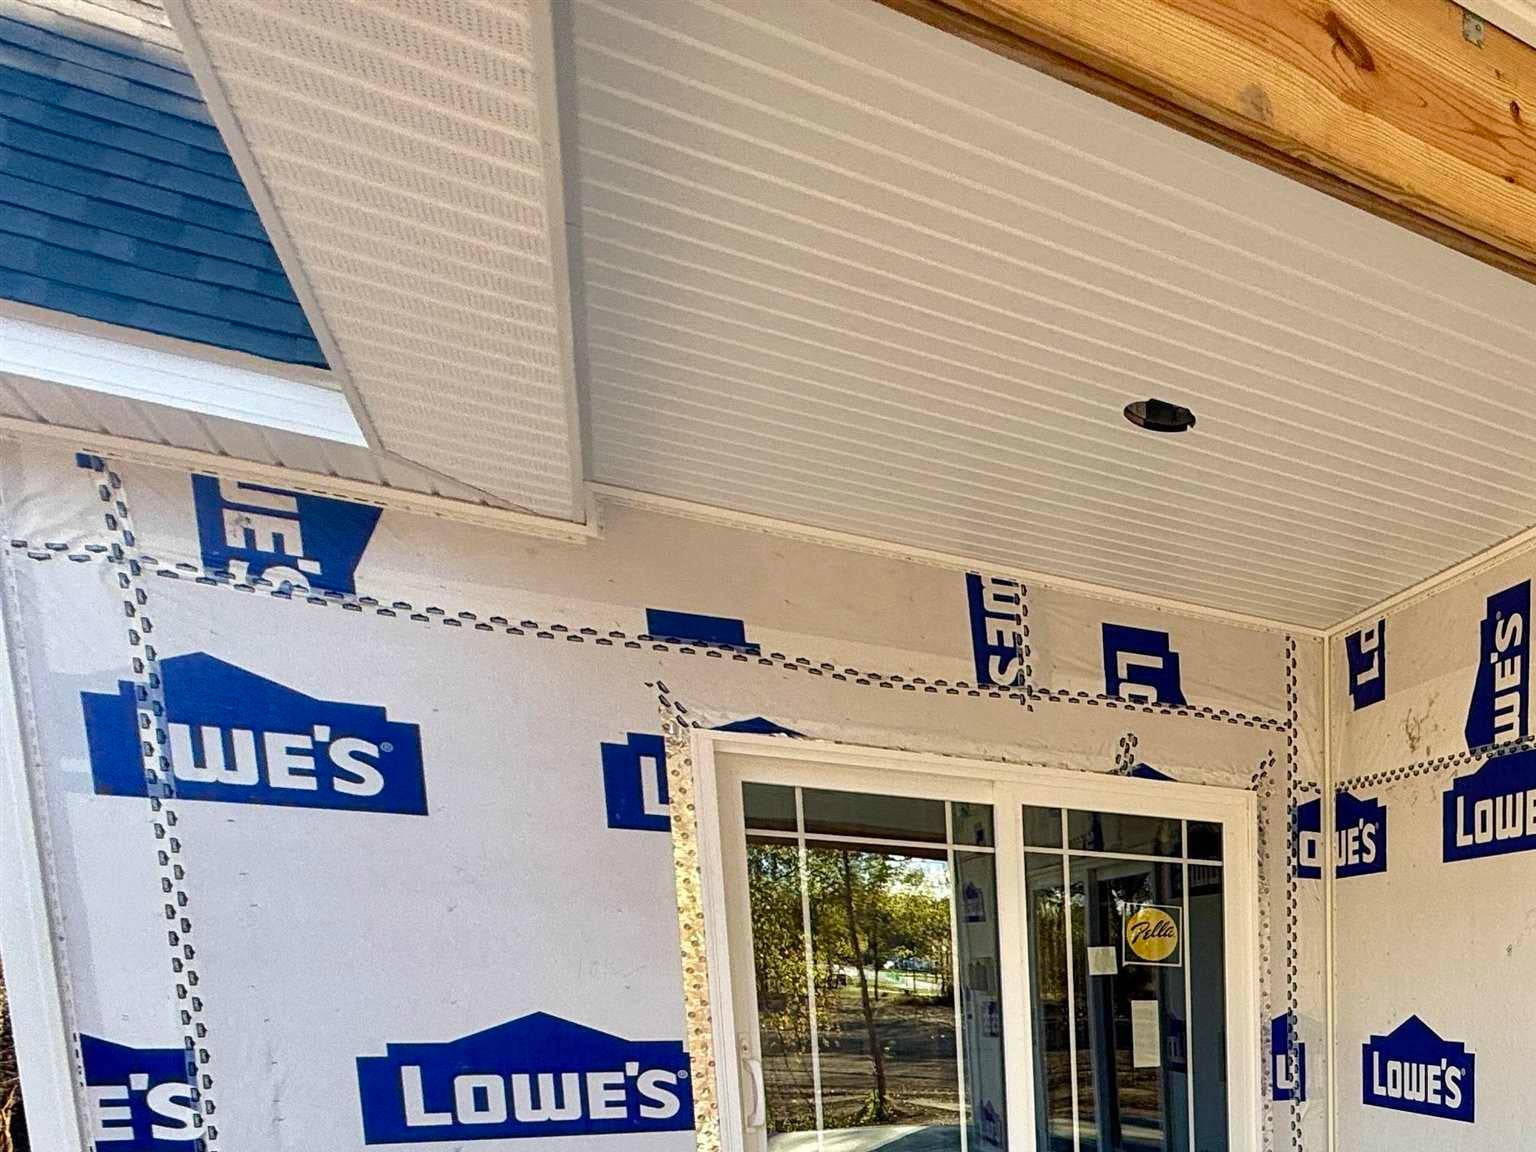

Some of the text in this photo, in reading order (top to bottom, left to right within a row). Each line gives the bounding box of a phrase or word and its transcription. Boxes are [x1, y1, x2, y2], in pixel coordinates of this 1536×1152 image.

[168, 722, 385, 797] WE'S
[1130, 920, 1176, 945] Pella
[400, 1061, 682, 1128] LOWE'S
[1373, 1050, 1463, 1109] LOWE'S
